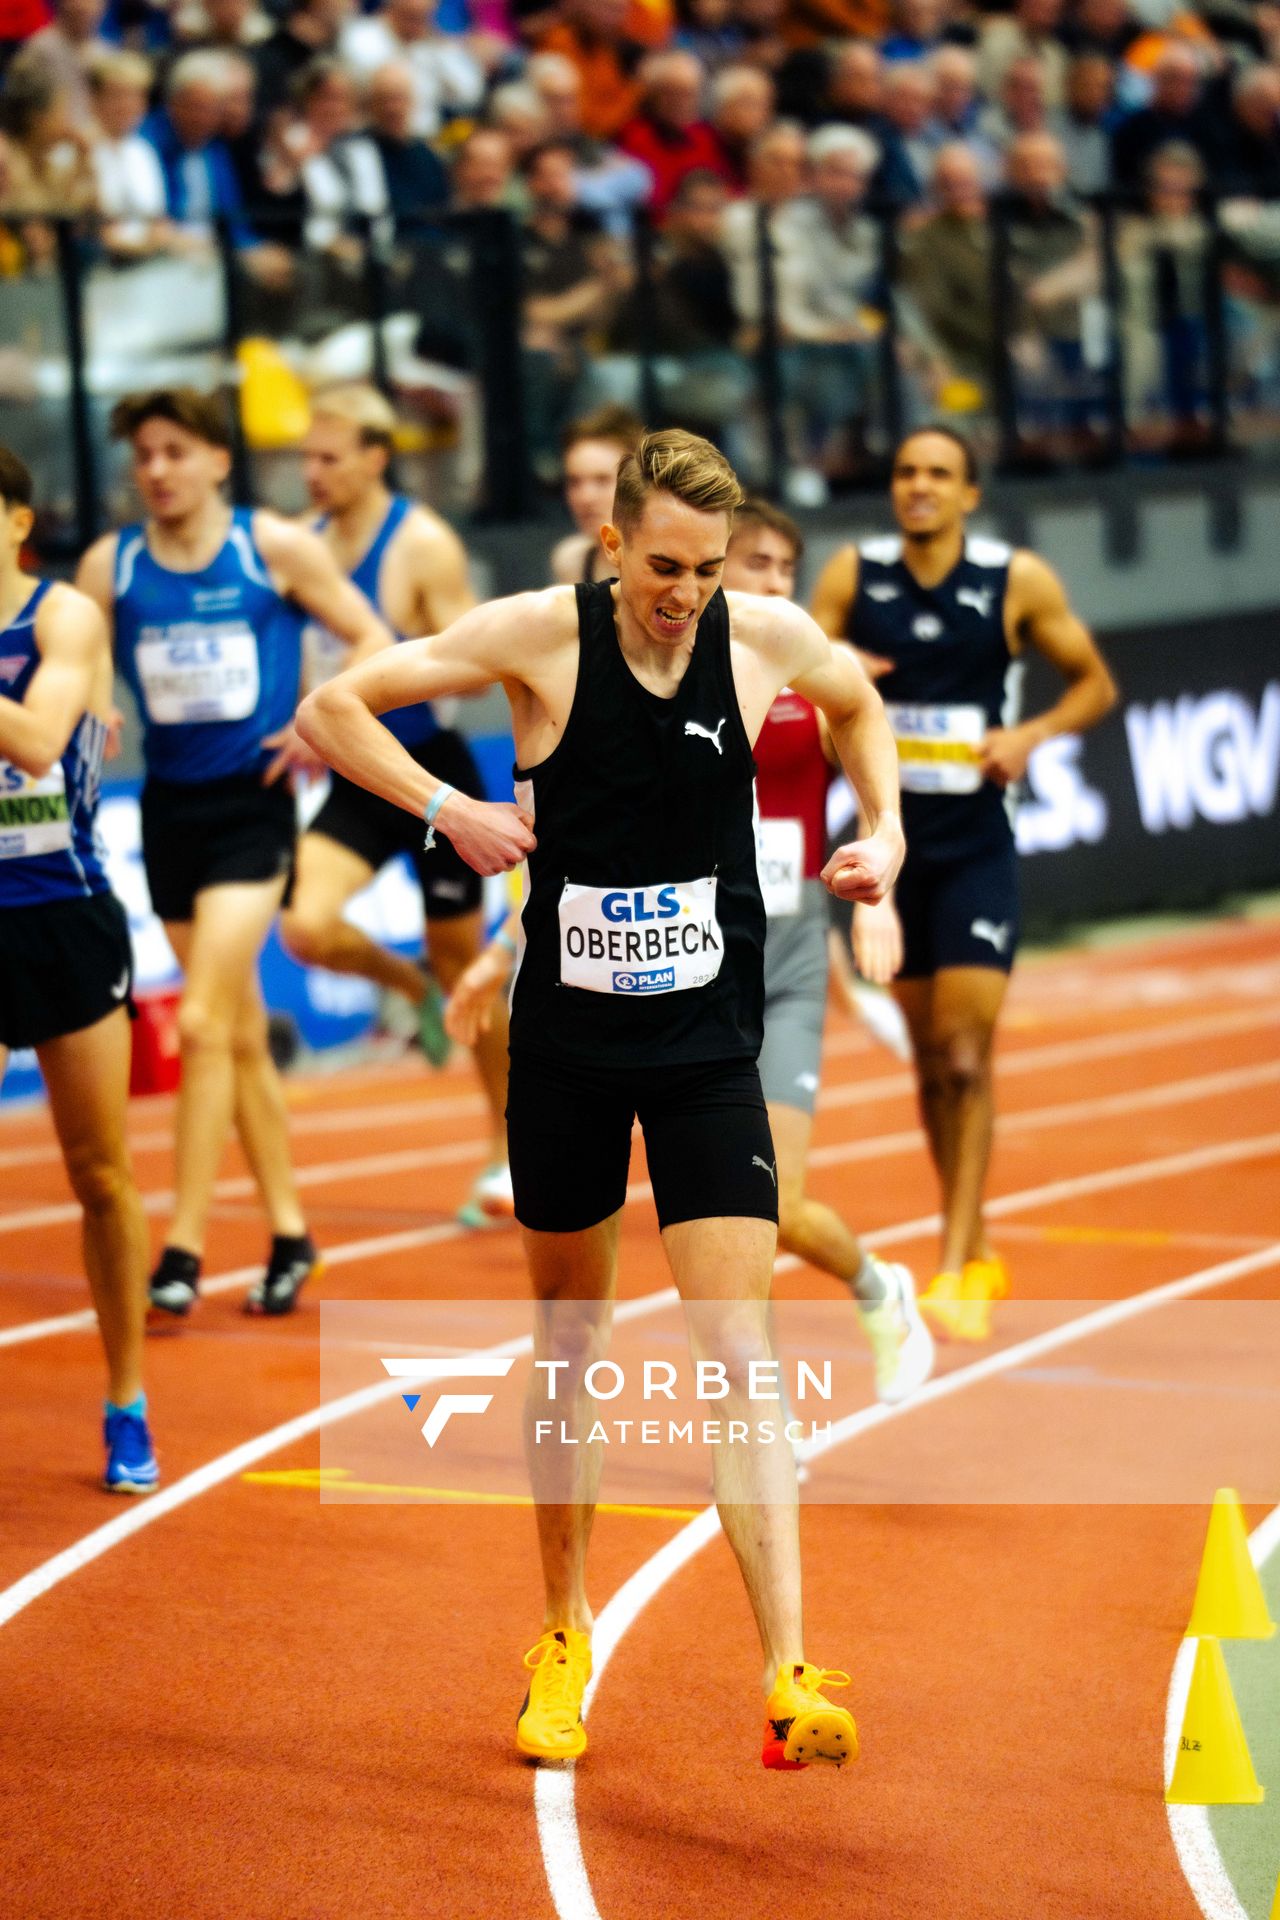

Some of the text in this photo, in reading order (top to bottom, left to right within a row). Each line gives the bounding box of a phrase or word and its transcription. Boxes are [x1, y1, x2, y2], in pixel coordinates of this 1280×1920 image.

[1124, 680, 1280, 834] WGV
[566, 919, 720, 963] OBERBECK
[638, 971, 673, 986] PLAN
